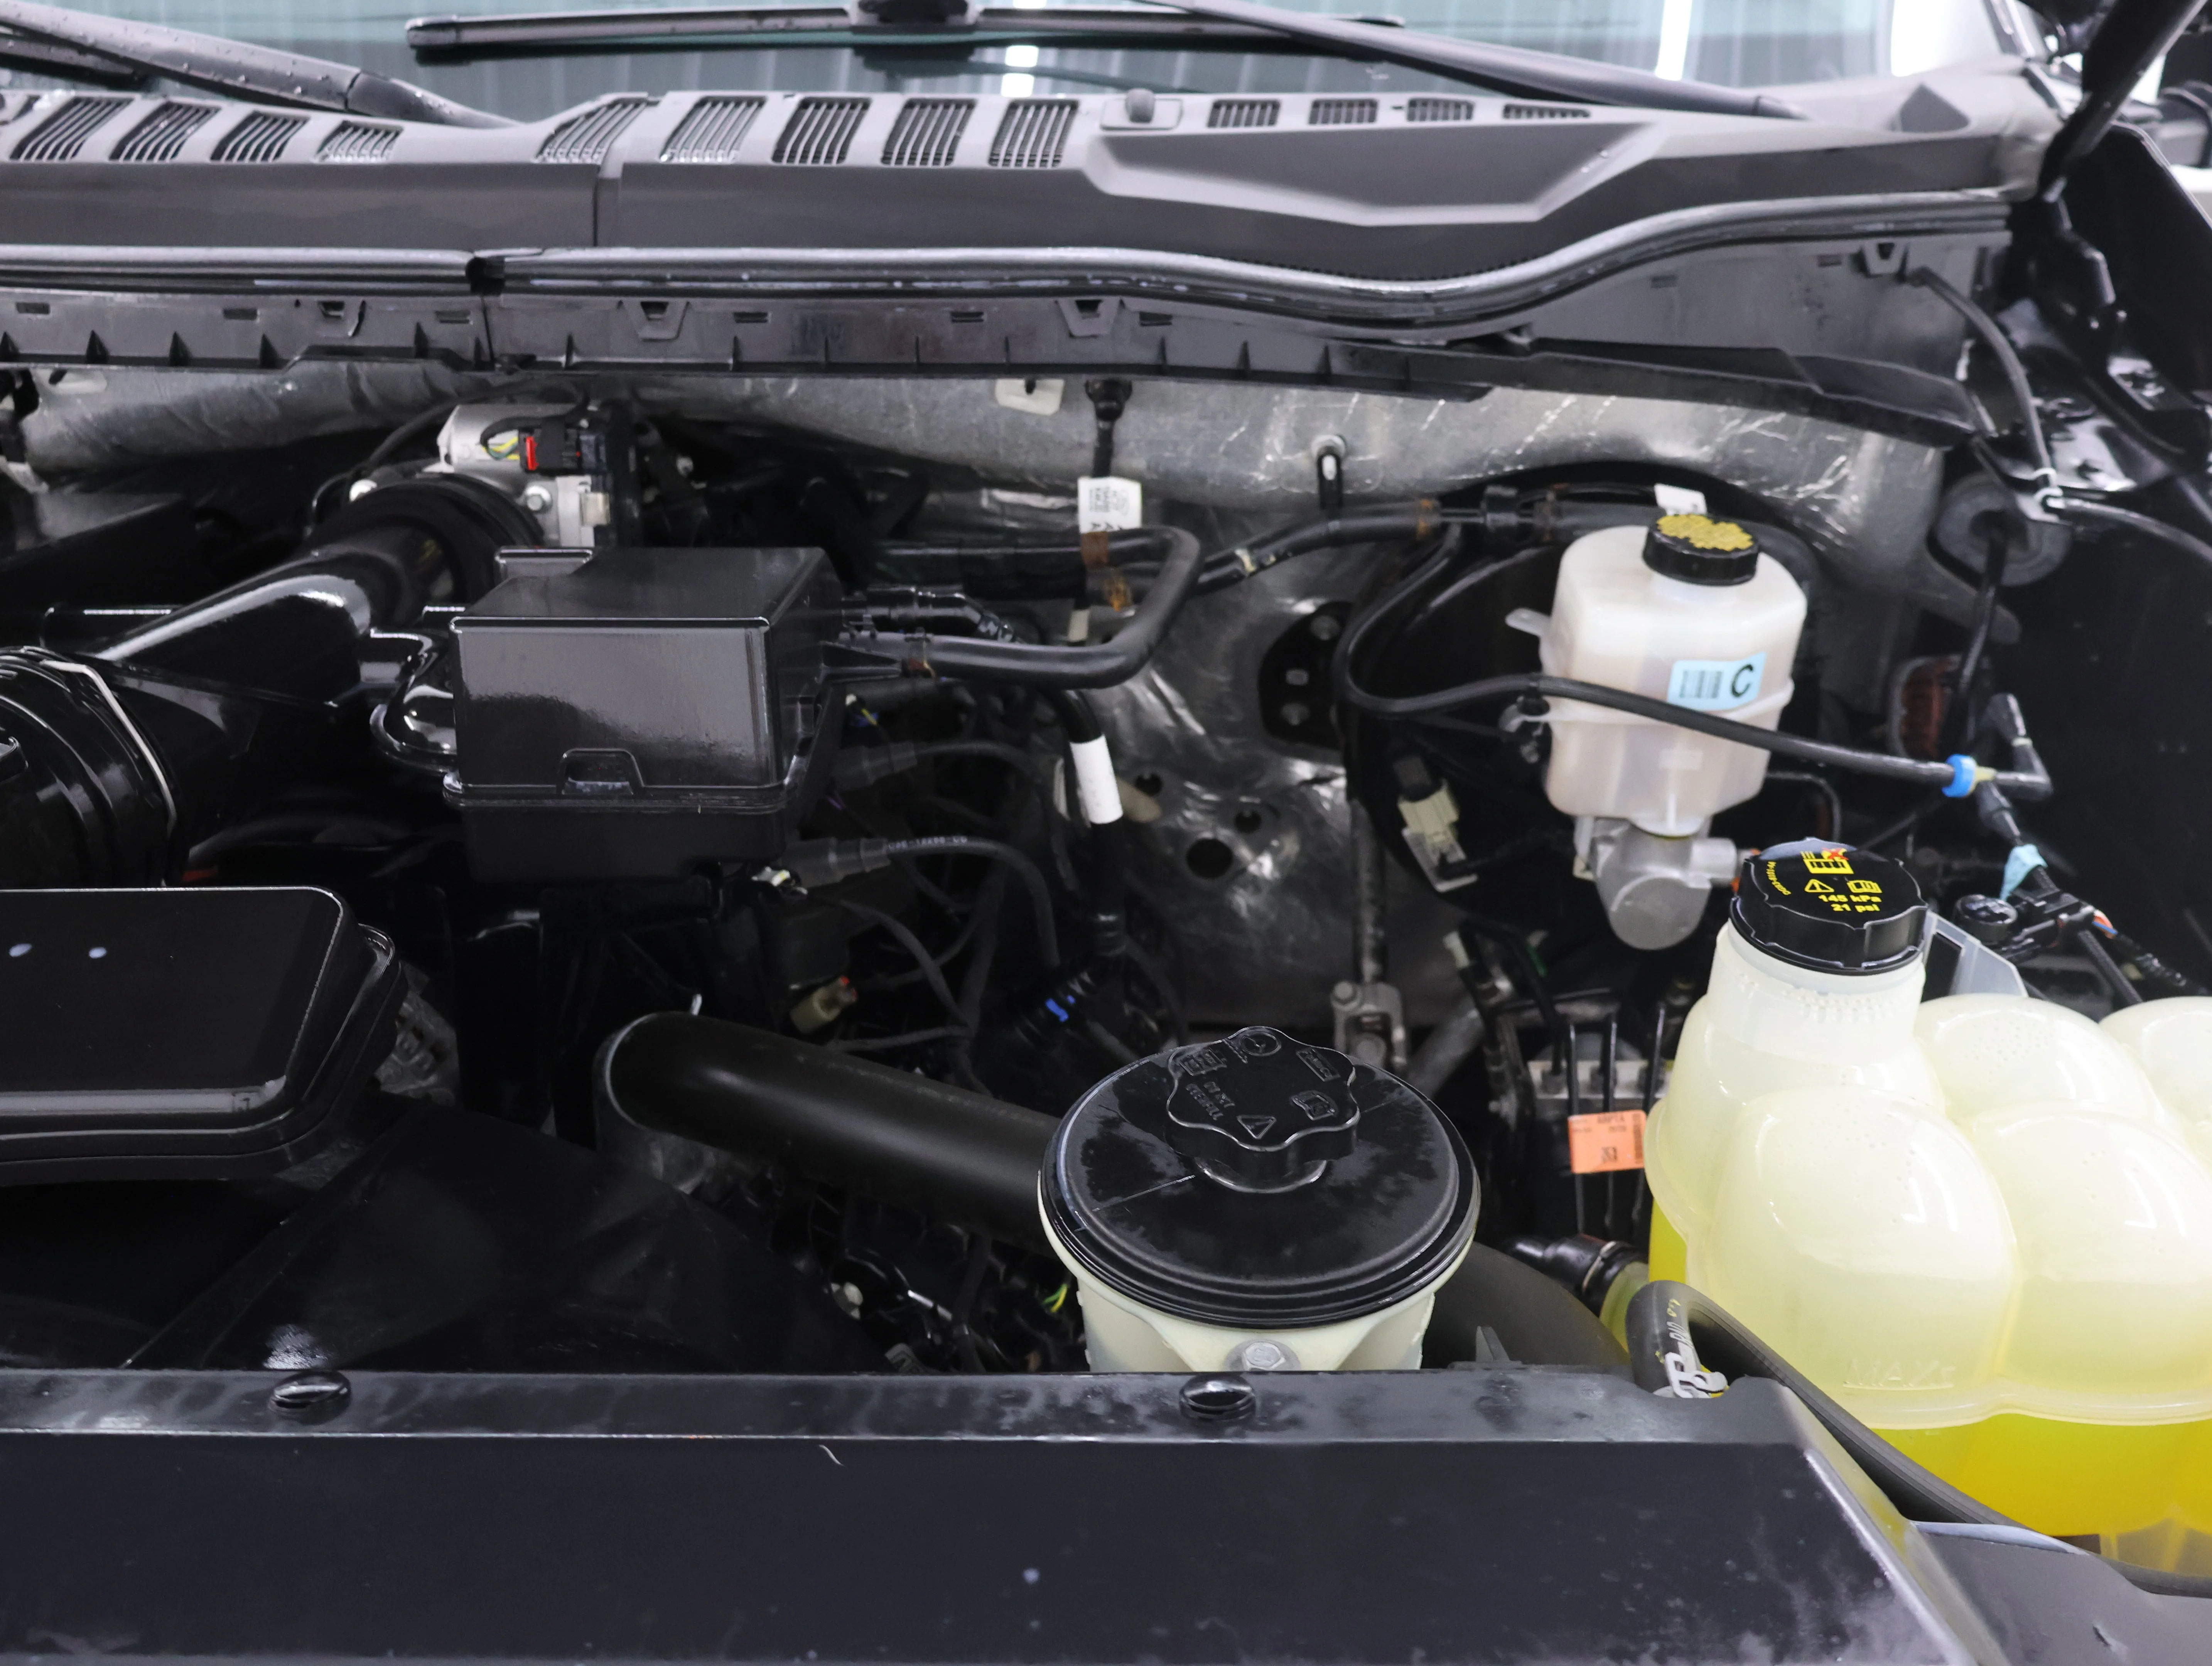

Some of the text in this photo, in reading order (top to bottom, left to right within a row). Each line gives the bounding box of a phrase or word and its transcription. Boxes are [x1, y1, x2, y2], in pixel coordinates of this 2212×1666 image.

[1731, 663, 1754, 698] C
[1849, 894, 1882, 902] kPa
[1854, 904, 1880, 913] psi
